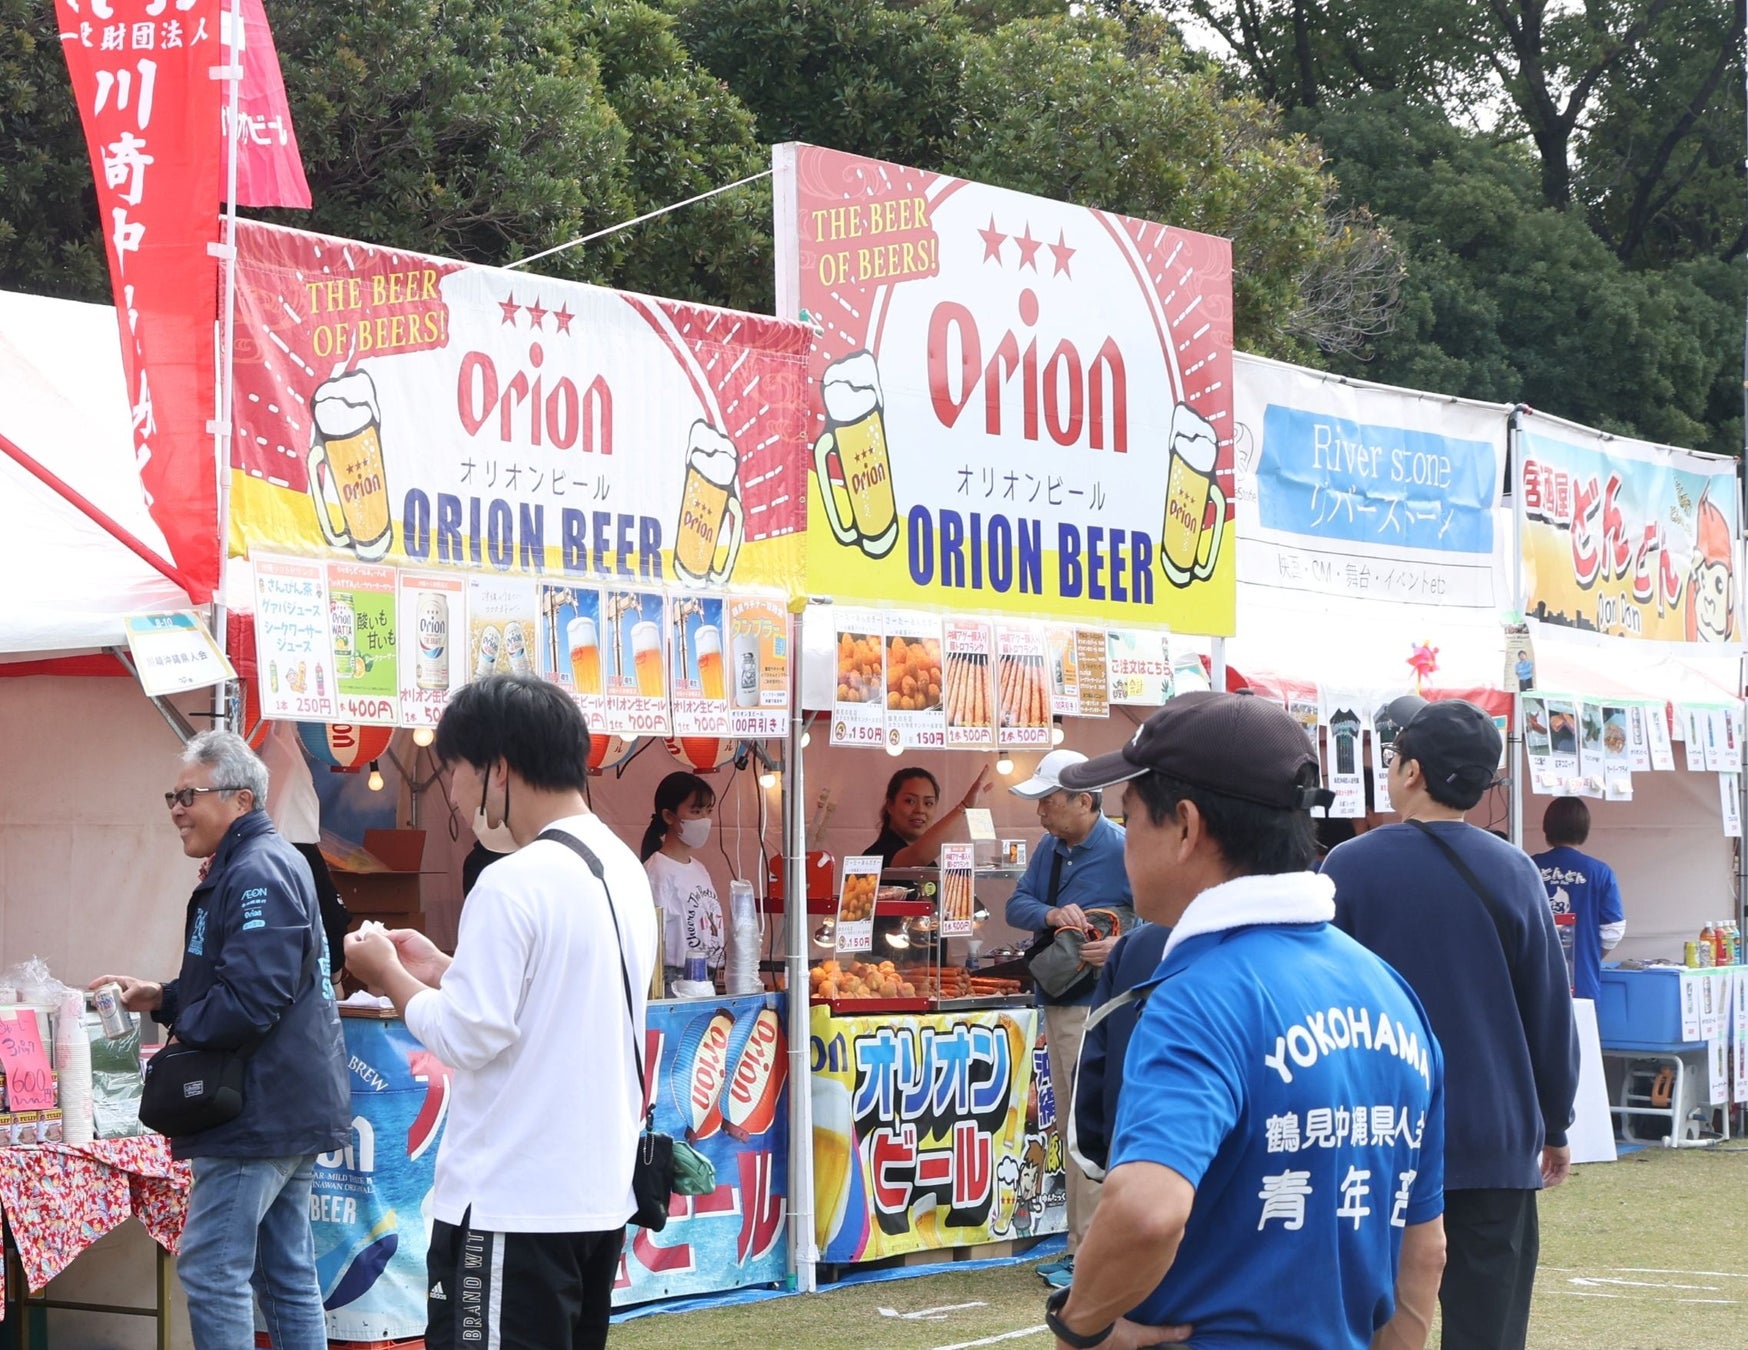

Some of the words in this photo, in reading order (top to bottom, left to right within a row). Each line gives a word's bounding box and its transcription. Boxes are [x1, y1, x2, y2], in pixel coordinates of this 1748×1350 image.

[812, 207, 862, 243] THE
[868, 197, 928, 233] BEER
[819, 254, 852, 286] OF
[857, 240, 937, 282] BEERS!
[306, 280, 363, 315] THE
[371, 269, 439, 304] BEER
[313, 322, 350, 359] OF
[358, 309, 449, 351] BEERS!
[927, 288, 1128, 453] Orion
[456, 341, 613, 456] Orion
[1311, 423, 1383, 479] River
[460, 456, 611, 501] オリオンビール
[957, 463, 1107, 511] オリオンビール
[1523, 459, 1570, 519] 居酒屋
[1308, 482, 1457, 540] リバーストーン
[402, 487, 545, 576] ORION
[561, 506, 664, 588] BEER
[908, 504, 1043, 595] ORION
[1059, 522, 1155, 605] BEER
[357, 609, 387, 630] 酸いも
[367, 629, 396, 650] 甘いも
[1112, 659, 1172, 676] ご注文はこちら
[296, 697, 332, 715] 250円
[349, 699, 394, 720] 400円
[400, 688, 449, 704] オリオン缶ビ
[607, 697, 667, 712] オリオン生ビール
[673, 701, 728, 713] オリオン生ビール
[405, 712, 418, 723] 1本
[628, 712, 669, 731] 700円
[694, 716, 729, 732] 700円
[851, 726, 882, 741] 150円
[963, 729, 992, 742] 500円
[1017, 729, 1048, 742] 500円
[917, 731, 945, 746] 150円
[849, 936, 870, 948] 150円
[1265, 1006, 1430, 1091] YOKOHAMA
[347, 1055, 389, 1092] BREW
[854, 1025, 1009, 1122] オリオン
[871, 1120, 993, 1214] ビール
[310, 1195, 357, 1225] BEER
[464, 1231, 485, 1269] WIT
[462, 1276, 483, 1342] BRAND
